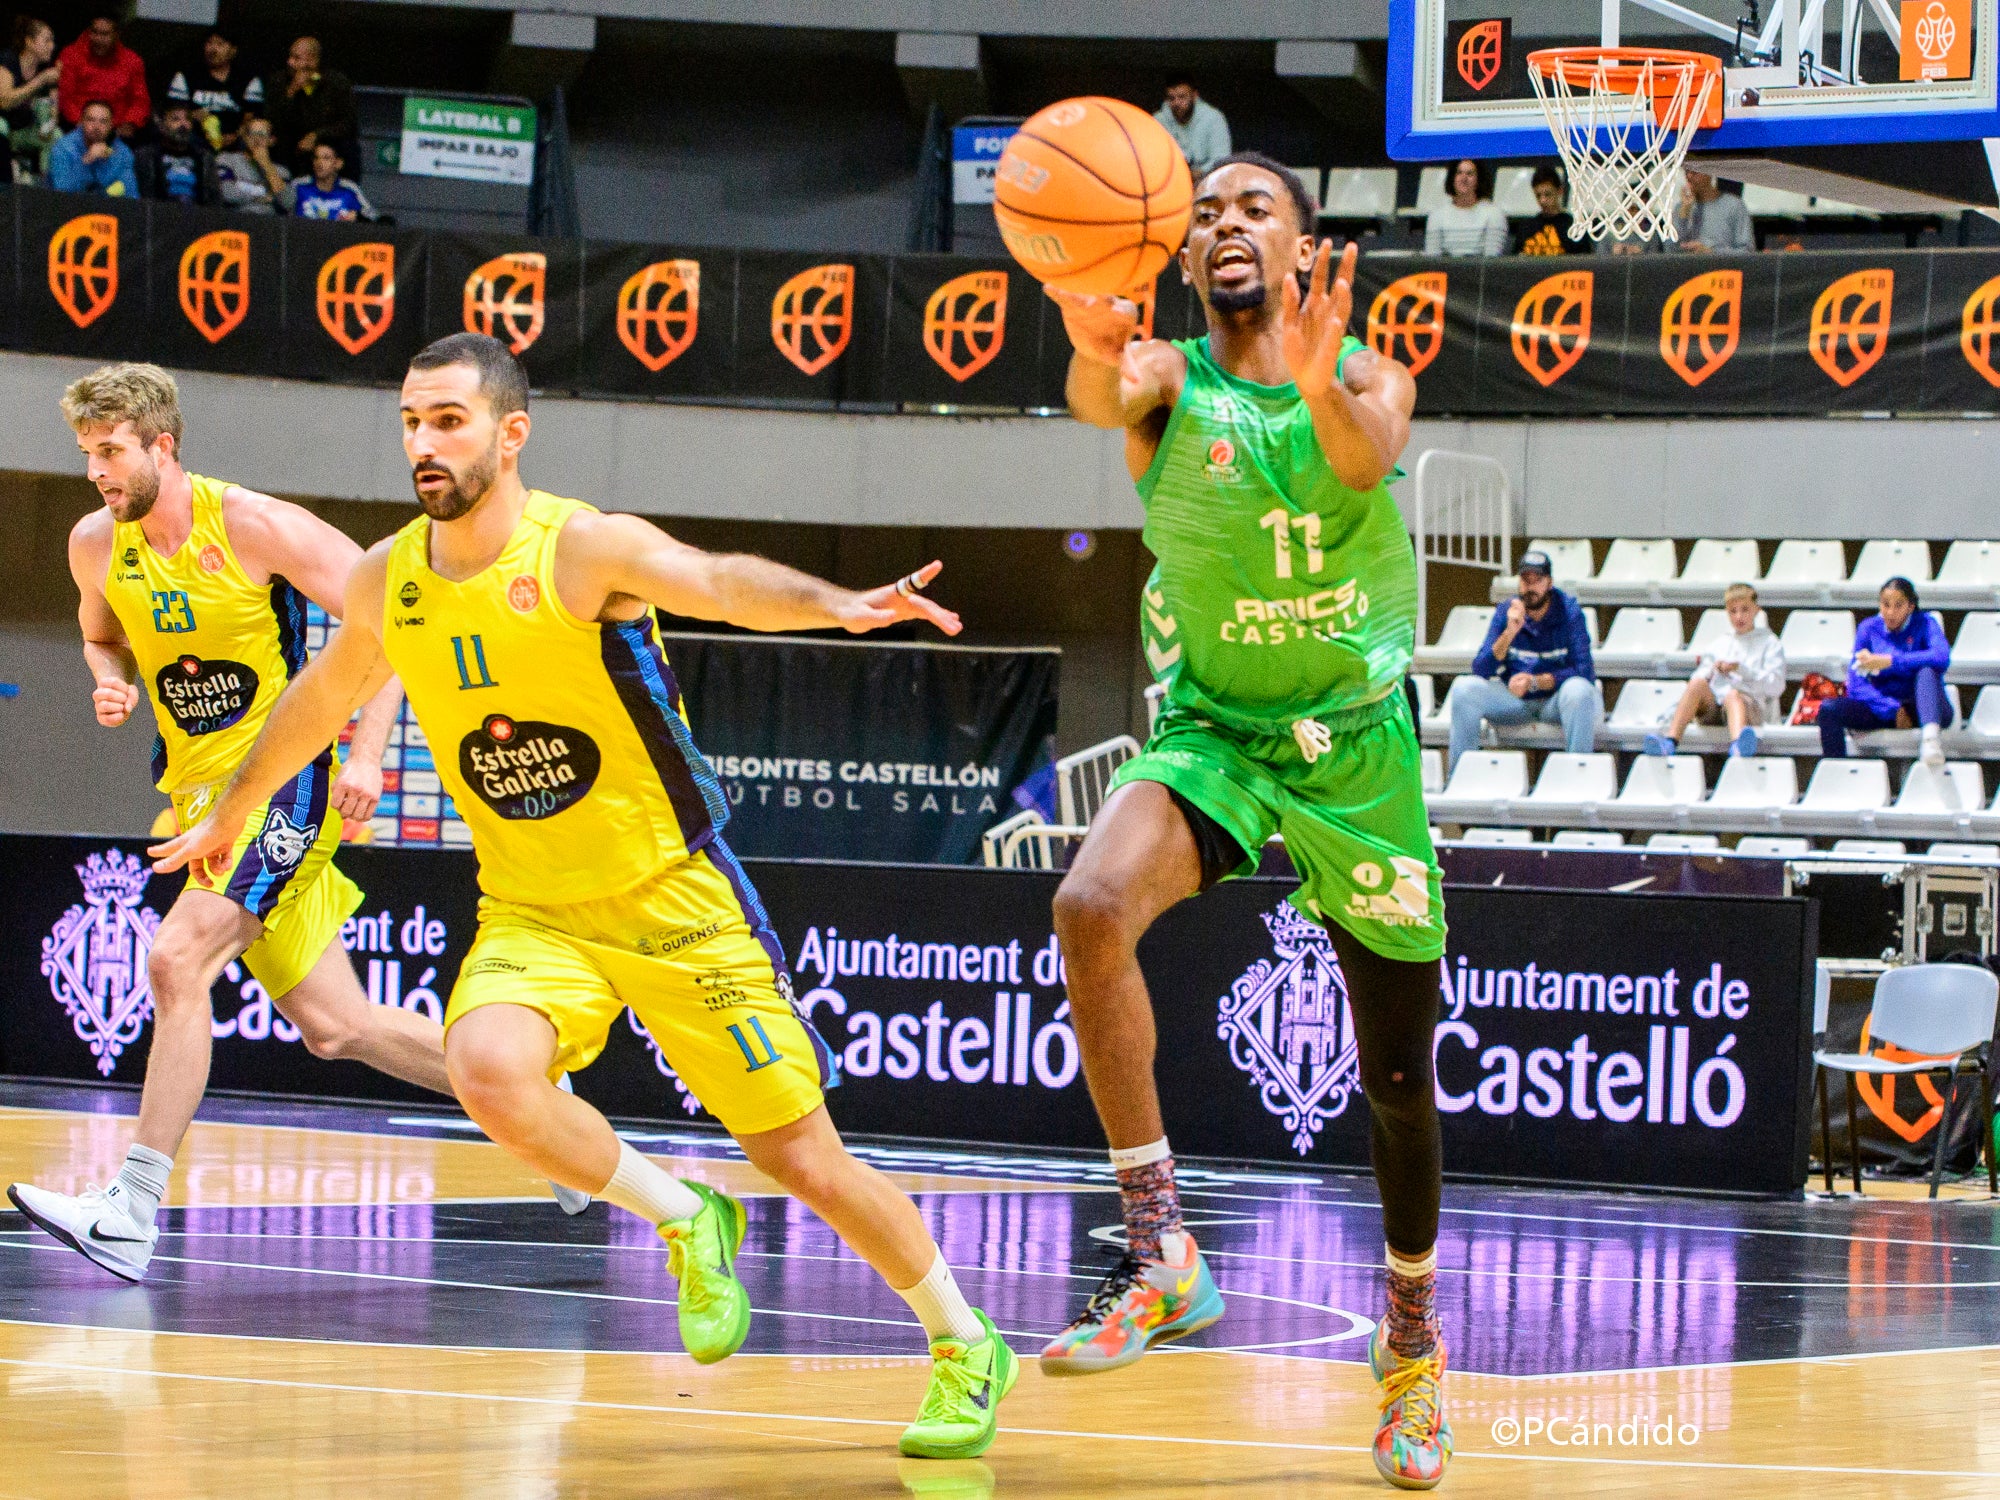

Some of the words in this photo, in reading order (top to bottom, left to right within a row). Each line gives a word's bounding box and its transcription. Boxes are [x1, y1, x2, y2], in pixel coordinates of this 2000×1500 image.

[1484, 25, 1498, 33] FEB
[417, 108, 503, 132] LATERAL
[417, 138, 469, 153] IMPAR
[474, 143, 519, 158] BAJO
[975, 278, 1000, 290] FEB
[1562, 279, 1587, 291] FEB
[1259, 508, 1324, 579] 11
[151, 590, 197, 634] 23
[1234, 578, 1357, 624] AMICS
[450, 634, 500, 691] 11
[163, 672, 241, 699] Estrella
[172, 694, 242, 719] Galicia
[470, 737, 570, 773] Estrella
[482, 762, 577, 799] Galicia
[839, 761, 999, 788] CASTELLÓN
[725, 781, 861, 811] ÚTBOL
[891, 790, 998, 816] SALA
[400, 904, 448, 956] de
[662, 922, 721, 953] OURENSE
[795, 925, 1023, 988] Ajuntament
[1693, 962, 1750, 1020] de
[726, 1015, 784, 1073] 11
[1432, 1019, 1747, 1129] Castelló
